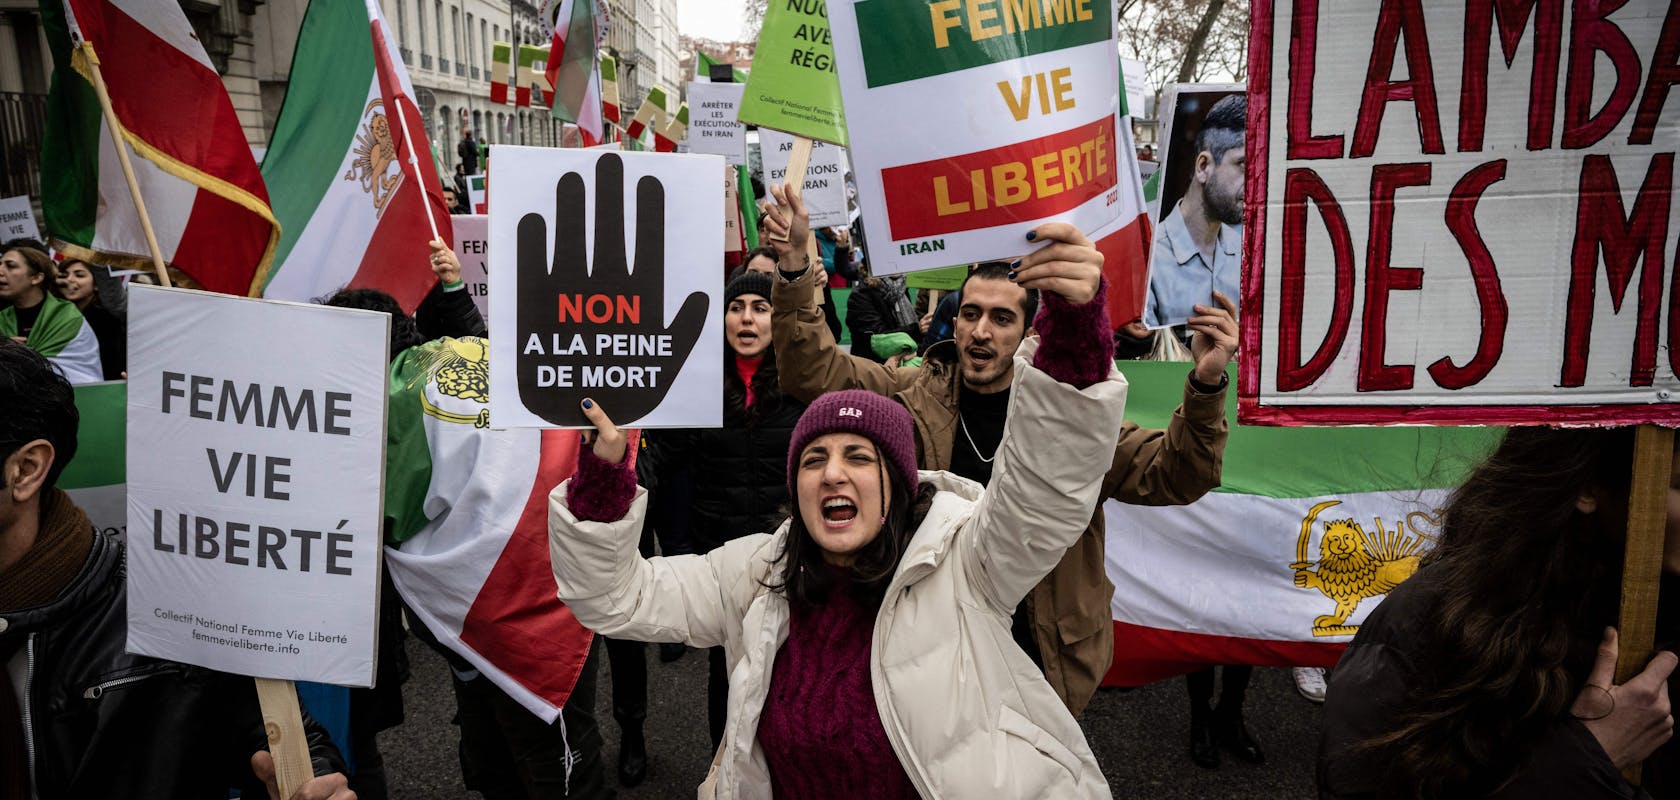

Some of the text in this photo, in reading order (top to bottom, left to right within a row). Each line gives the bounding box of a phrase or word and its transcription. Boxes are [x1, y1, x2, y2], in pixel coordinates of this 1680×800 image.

[929, 0, 1093, 49] FEMME
[701, 101, 734, 109] ARRÊTER
[997, 67, 1076, 122] VIE
[694, 119, 742, 128] EXÉCUTIONS
[714, 130, 733, 138] IRAN
[933, 126, 1107, 217] LIBERTÉ
[900, 239, 946, 257] IRAN
[1276, 152, 1680, 392] DES M
[558, 293, 641, 324] NON
[523, 333, 673, 357] A LA PEINE
[537, 366, 662, 388] DE MORT
[161, 370, 353, 436] FEMME
[839, 407, 863, 418] GAP
[206, 447, 291, 501] VIE
[153, 509, 354, 577] LIBERTÉ
[154, 607, 348, 645] Collectif National Femme Vie Liberté
[192, 629, 301, 655] femmevieliberte.info
